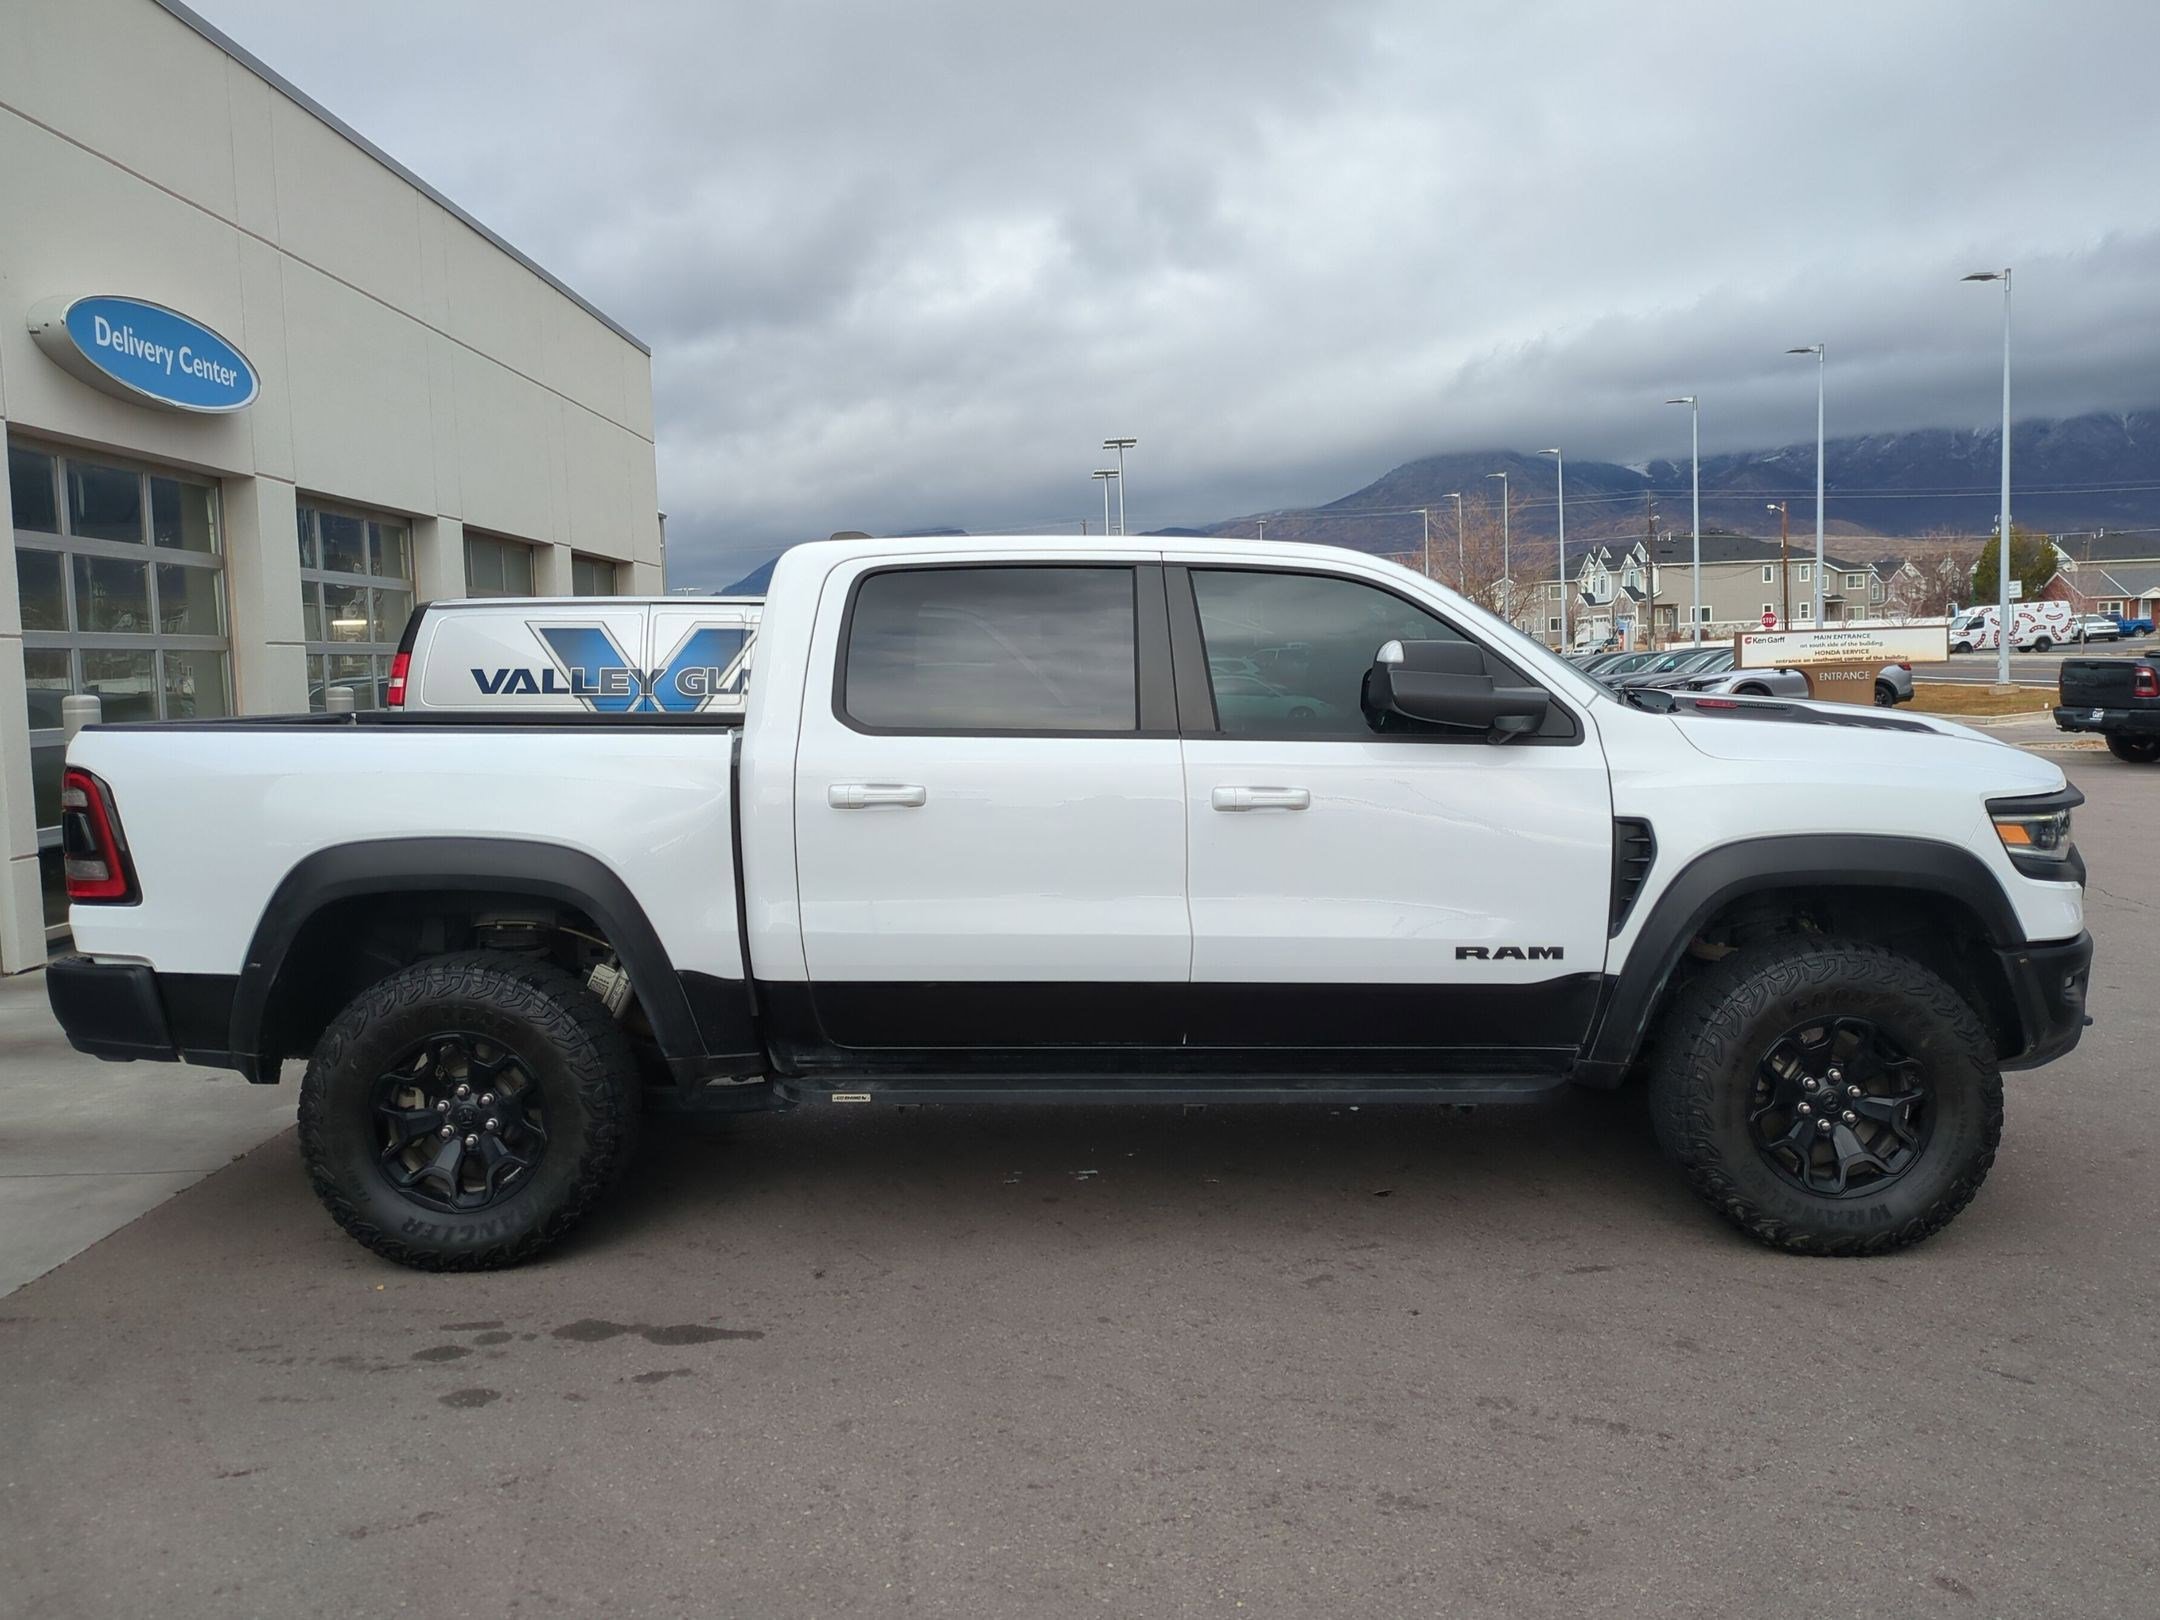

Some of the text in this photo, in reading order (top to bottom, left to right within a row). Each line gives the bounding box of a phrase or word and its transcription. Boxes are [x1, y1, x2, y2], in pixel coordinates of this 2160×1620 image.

[94, 315, 238, 388] Delivery Center
[1762, 616, 1777, 624] STOP
[1752, 635, 1786, 644] Ken Garff
[470, 667, 668, 696] VALLEY
[1819, 670, 1871, 681] ENTRANCE
[1455, 946, 1564, 960] RAM
